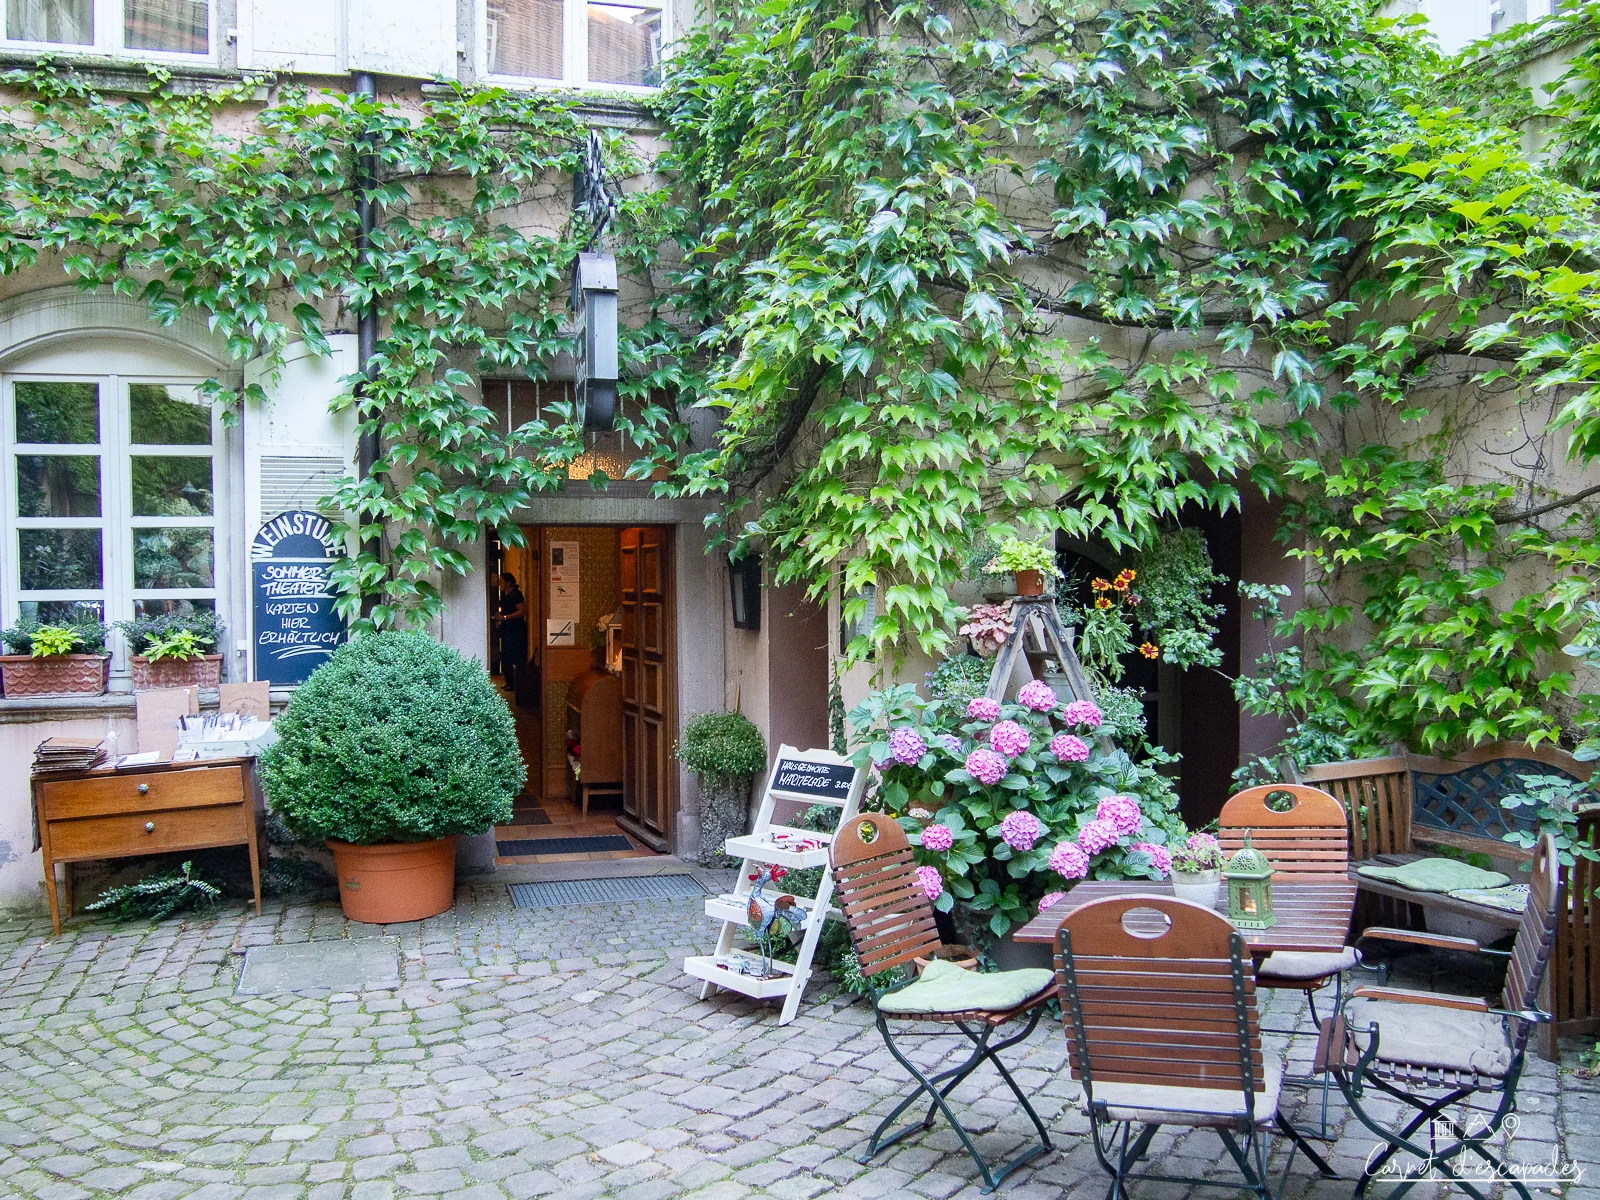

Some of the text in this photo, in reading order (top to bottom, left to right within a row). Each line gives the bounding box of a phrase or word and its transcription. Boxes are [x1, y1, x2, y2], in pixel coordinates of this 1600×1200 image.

[260, 581, 329, 596] THEATER
[265, 602, 319, 616] KARTEN
[281, 617, 311, 629] HIER
[259, 630, 341, 645] ERHÄLTLICH
